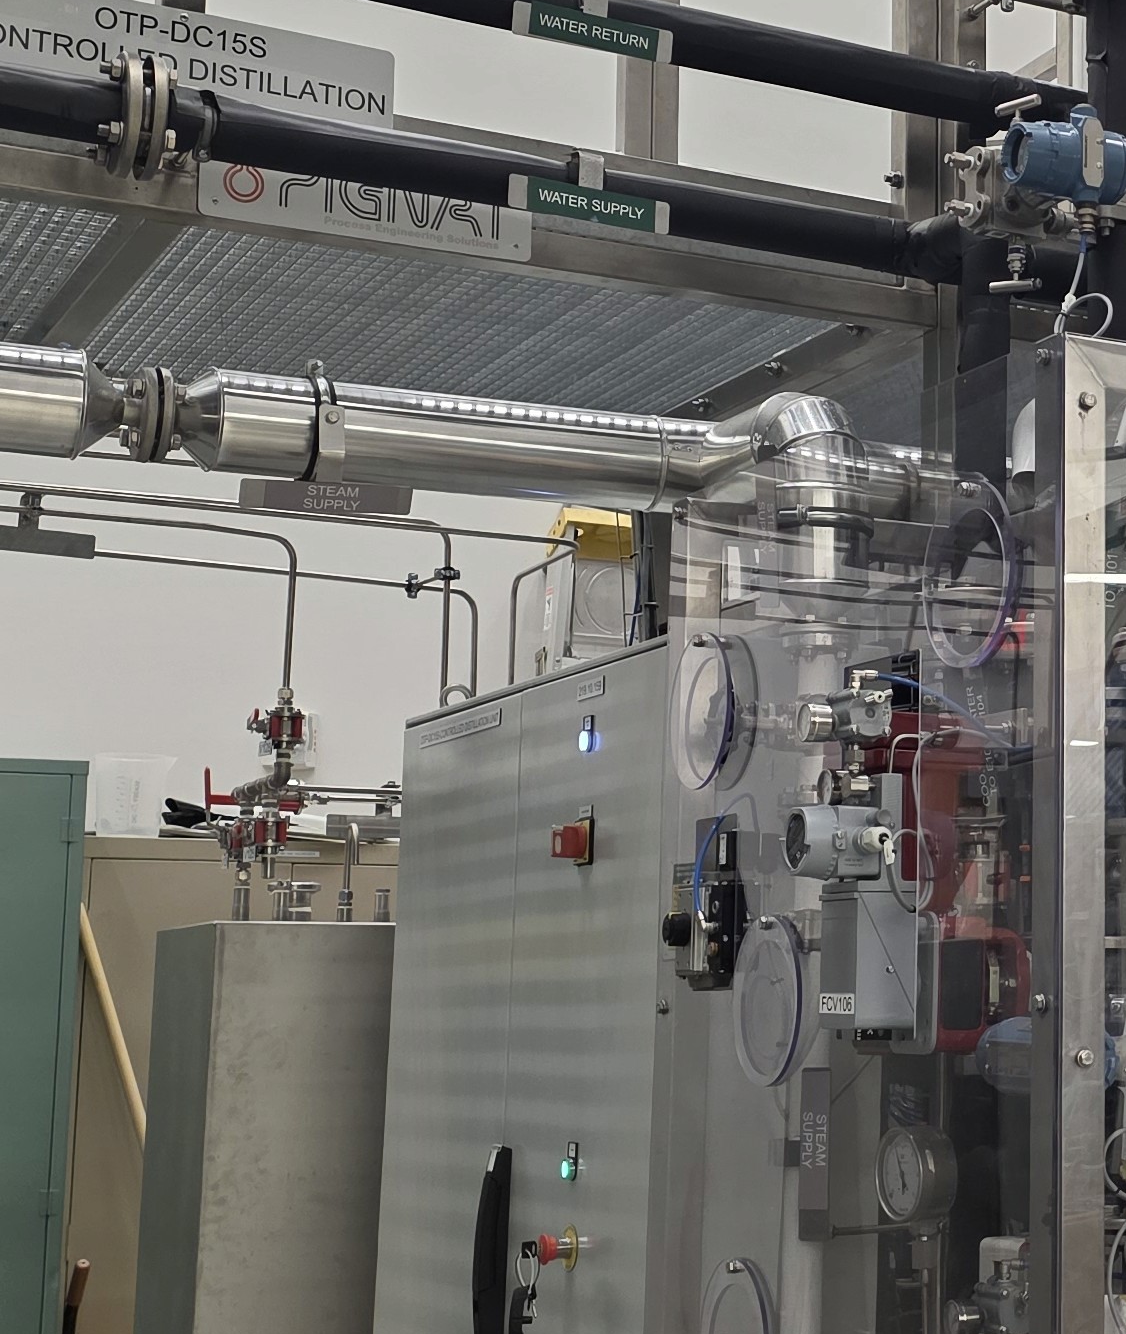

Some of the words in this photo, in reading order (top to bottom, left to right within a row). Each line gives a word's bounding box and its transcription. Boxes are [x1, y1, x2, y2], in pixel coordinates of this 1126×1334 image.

[94, 6, 267, 59] OTP-DC15S
[539, 12, 588, 36] WATER
[591, 24, 649, 50] RETURN
[188, 58, 386, 116] DISTILLATION
[539, 188, 588, 210] WATER
[591, 199, 645, 220] SUPPLY
[324, 215, 372, 233] Process
[375, 222, 446, 244] Engineering
[447, 233, 500, 250] Solutions
[303, 498, 361, 511] SUPPLY
[307, 485, 360, 498] STEAM
[821, 995, 852, 1012] FCV106
[801, 1111, 814, 1169] SUPPLY
[815, 1114, 827, 1166] STEAM
